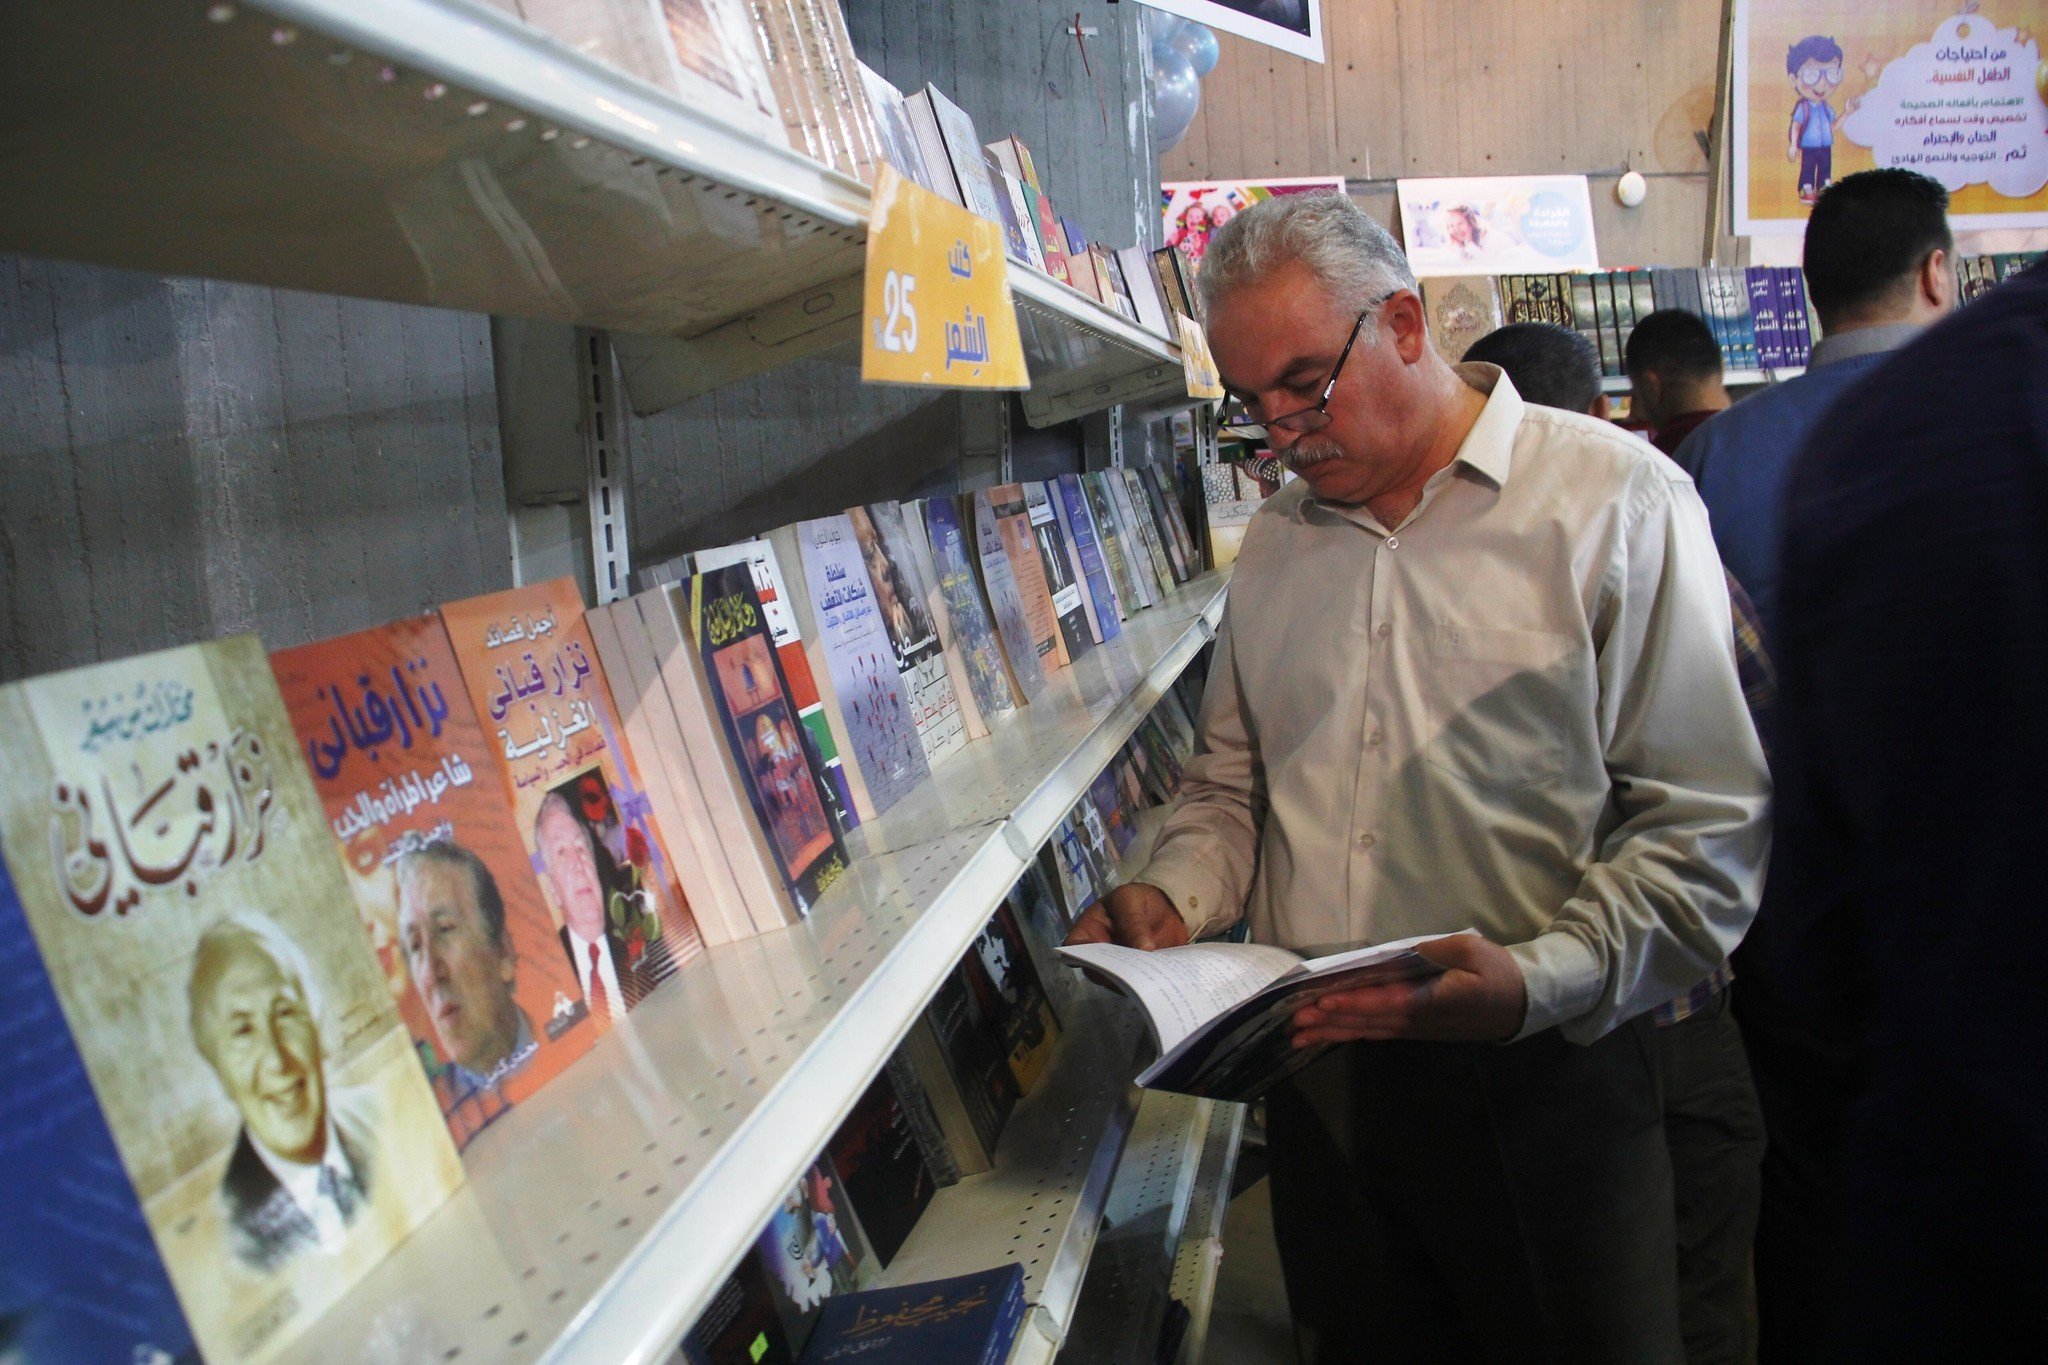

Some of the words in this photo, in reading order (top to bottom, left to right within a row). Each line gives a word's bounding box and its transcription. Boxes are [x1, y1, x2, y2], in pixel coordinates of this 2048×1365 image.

[1935, 45, 1988, 62] احتياجات
[1990, 48, 2007, 62] من
[1977, 66, 2011, 85] الطفل
[1895, 113, 1927, 127] أفكاره
[1928, 115, 1961, 127] لسماع
[1963, 114, 1985, 125] وقت
[1967, 130, 1997, 145] الحنان
[2005, 144, 2027, 162] ثم
[947, 240, 971, 283] كتب
[552, 641, 592, 696] نزار
[385, 656, 448, 749] نزار
[425, 753, 473, 804] شاعر
